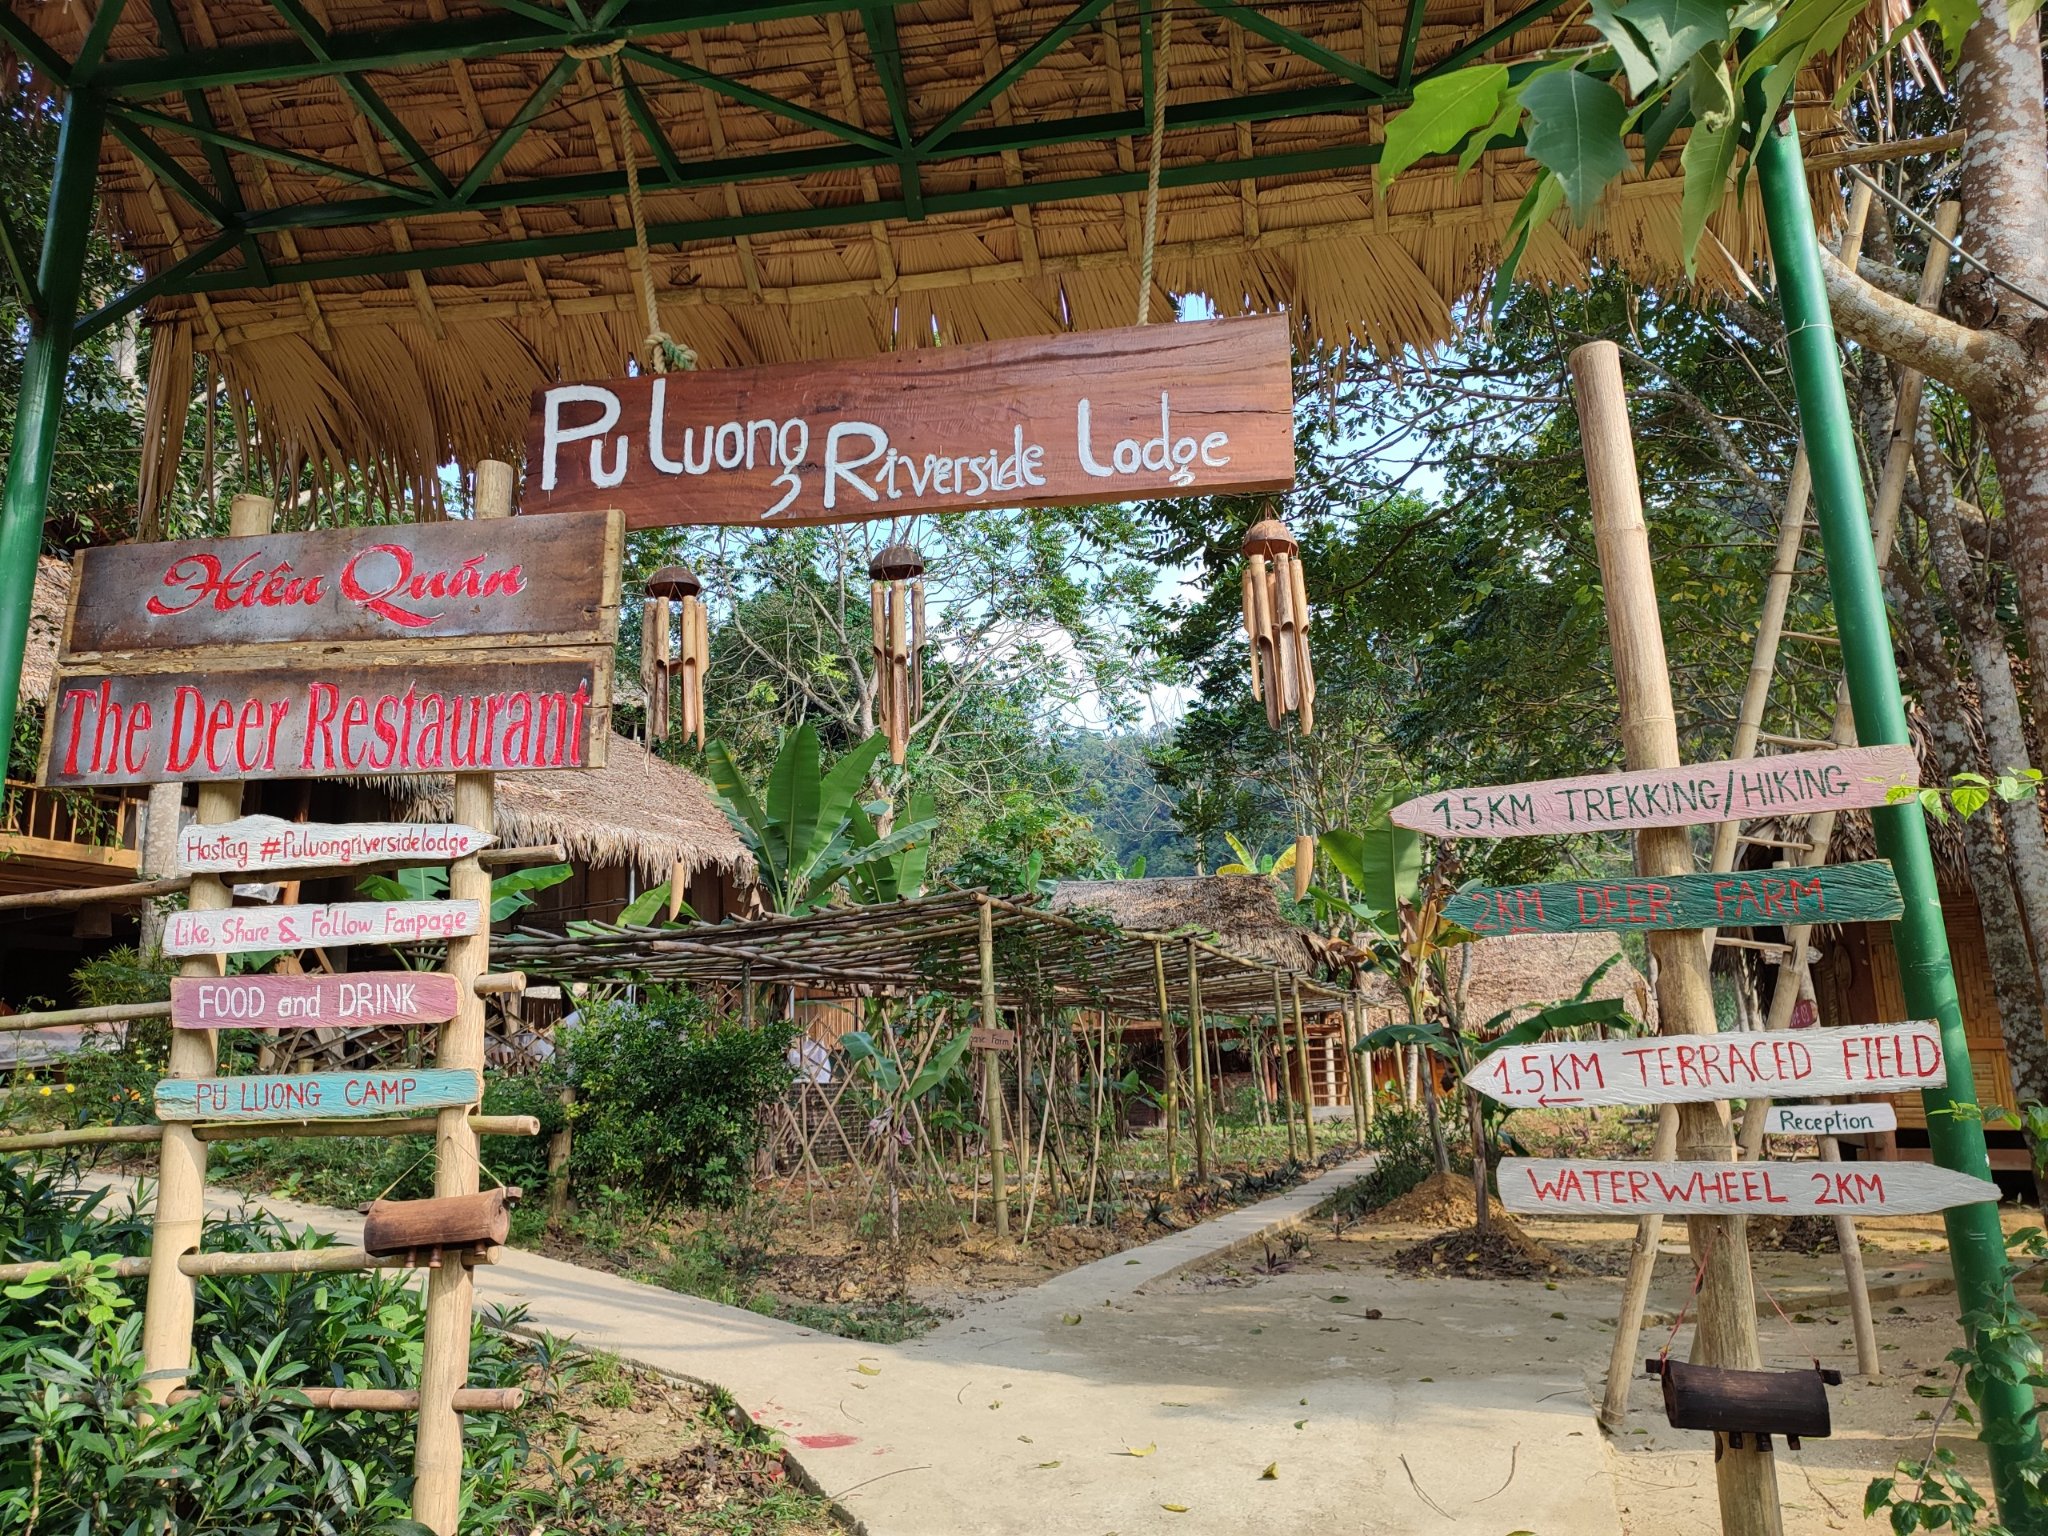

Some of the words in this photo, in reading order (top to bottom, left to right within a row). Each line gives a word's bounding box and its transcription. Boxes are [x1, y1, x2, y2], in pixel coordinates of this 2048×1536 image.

[541, 384, 628, 490] Pu
[650, 378, 808, 519] Luong
[823, 422, 1047, 510] Riverside
[1078, 390, 1231, 487] Lodge
[340, 543, 528, 628] Quán
[60, 679, 152, 775] The
[165, 685, 289, 773] Deer
[302, 677, 592, 771] Restaurant
[1433, 795, 1536, 831] 1.5KM
[1554, 765, 1850, 823] TREKKING/HIKING
[174, 915, 214, 947] Like,
[222, 917, 270, 945] Share
[278, 916, 301, 943] &
[311, 907, 373, 939] Follow
[385, 907, 468, 940] Fanpage
[1471, 888, 1546, 933] 2KM
[1577, 883, 1673, 926] DEER
[1713, 876, 1826, 920] FARM
[198, 984, 266, 1018] FOOD
[277, 985, 321, 1018] and
[339, 982, 418, 1018] DRINK
[1493, 1053, 1605, 1096] 1.5KM
[1621, 1041, 1811, 1088] TERRACED
[1842, 1034, 1941, 1080] FIELD
[193, 1083, 227, 1114] PU
[241, 1081, 321, 1112] LUONG
[344, 1078, 417, 1107] CAMP
[1780, 1110, 1874, 1133] Reception
[1811, 1172, 1886, 1205] 2KM
